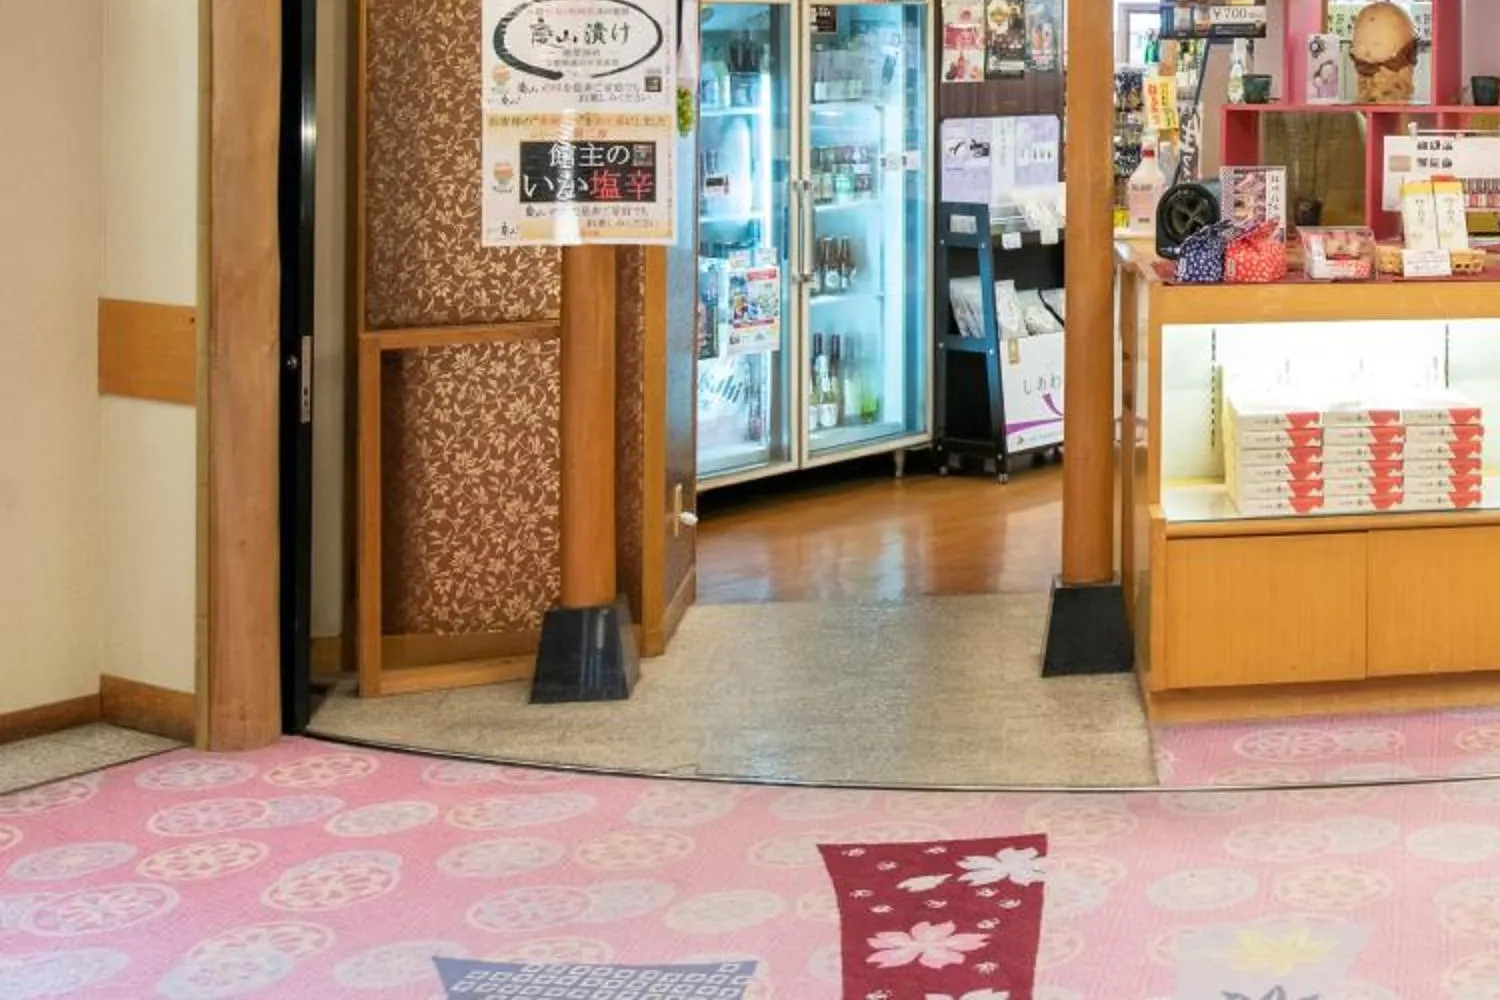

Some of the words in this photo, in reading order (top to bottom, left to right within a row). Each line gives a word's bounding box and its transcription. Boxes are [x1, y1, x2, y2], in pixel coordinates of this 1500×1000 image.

[549, 143, 630, 169] 館主の
[522, 169, 654, 201] いか塩辛
